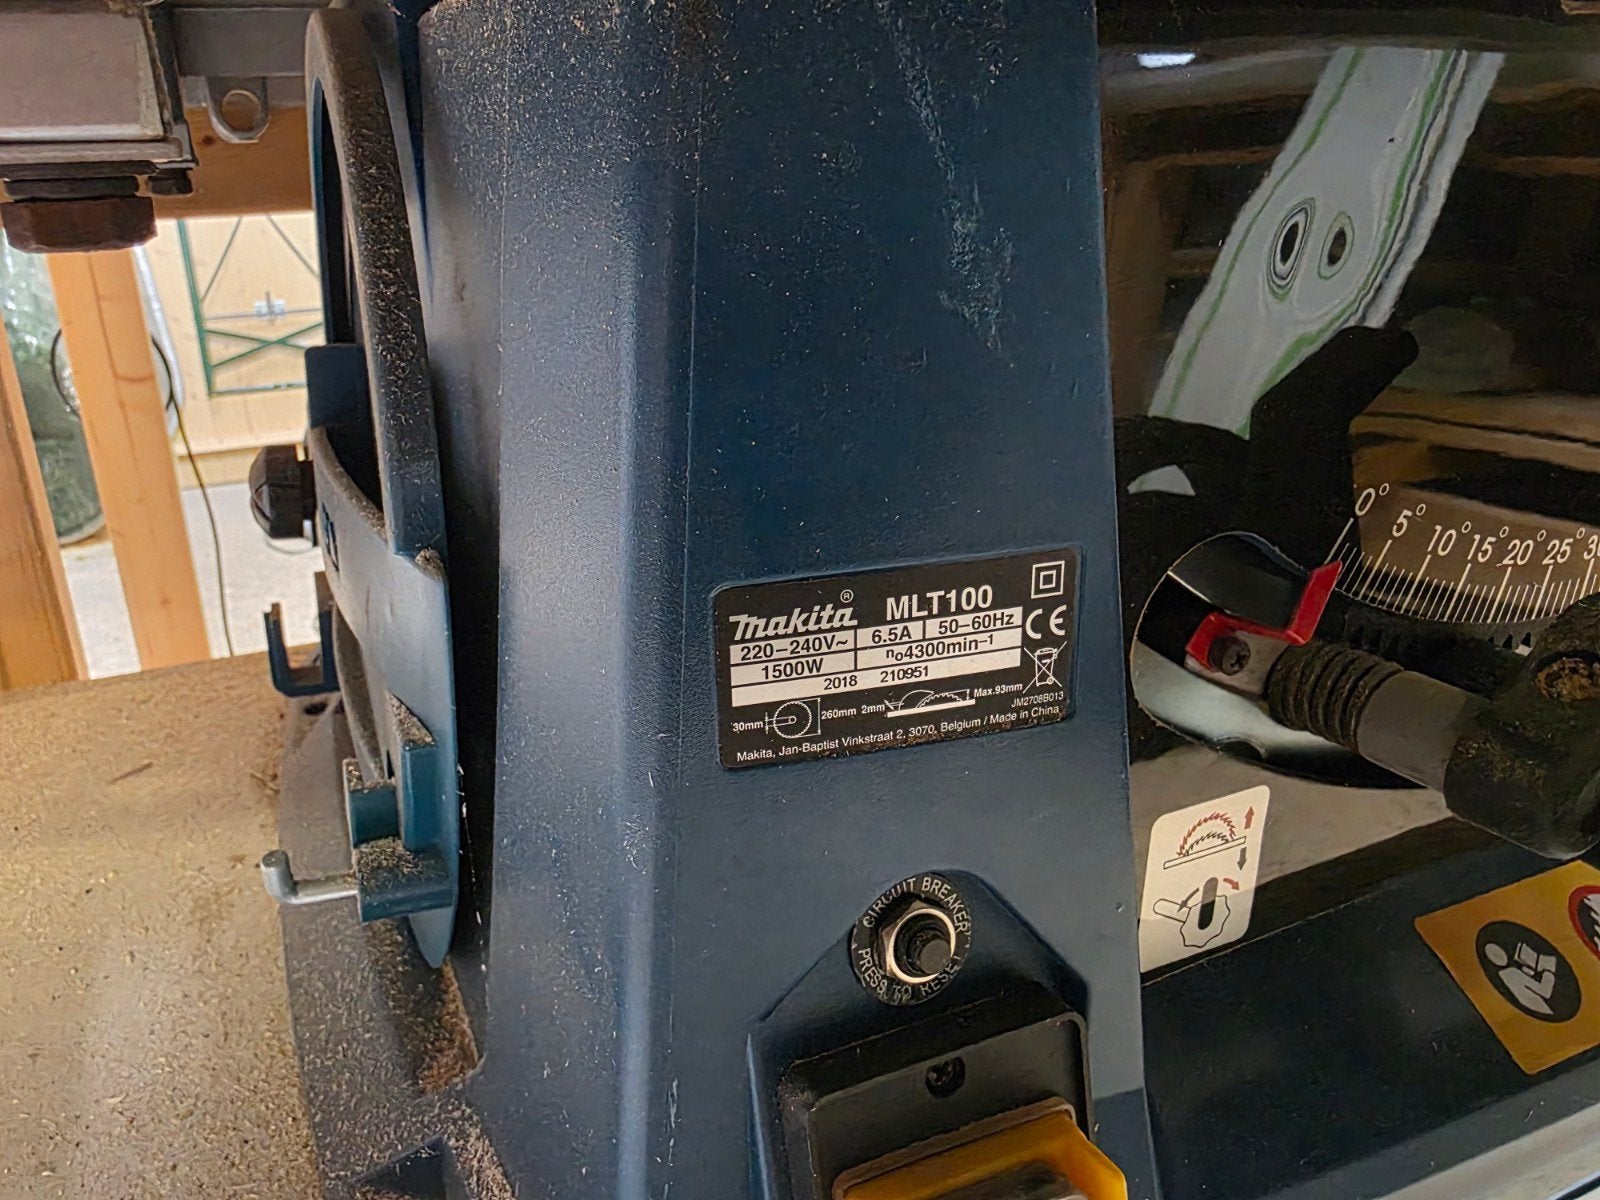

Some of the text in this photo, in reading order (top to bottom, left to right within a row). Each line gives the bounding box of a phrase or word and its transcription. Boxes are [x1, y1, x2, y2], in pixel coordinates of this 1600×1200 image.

[1583, 534, 1600, 560] 3
[886, 584, 993, 621] MLT100
[871, 625, 912, 645] 6.5A
[938, 611, 1015, 635] 50-60Hz
[761, 657, 824, 680] 1500W
[823, 665, 930, 691] 2018 210951
[974, 683, 1023, 698] Max.93mm
[821, 706, 857, 720] 260mm
[861, 703, 886, 714] 2mm
[732, 721, 764, 732] 30mm
[736, 750, 776, 762] Makita,
[779, 739, 839, 757] Jan-Baptist
[842, 731, 894, 747] Vinkstraat
[940, 717, 981, 733] Belgium
[990, 712, 1017, 725] Made
[1019, 709, 1029, 719] in
[1031, 705, 1060, 717] China
[863, 877, 971, 933] CIRCUIT BREAKER
[858, 947, 888, 994] PRESS
